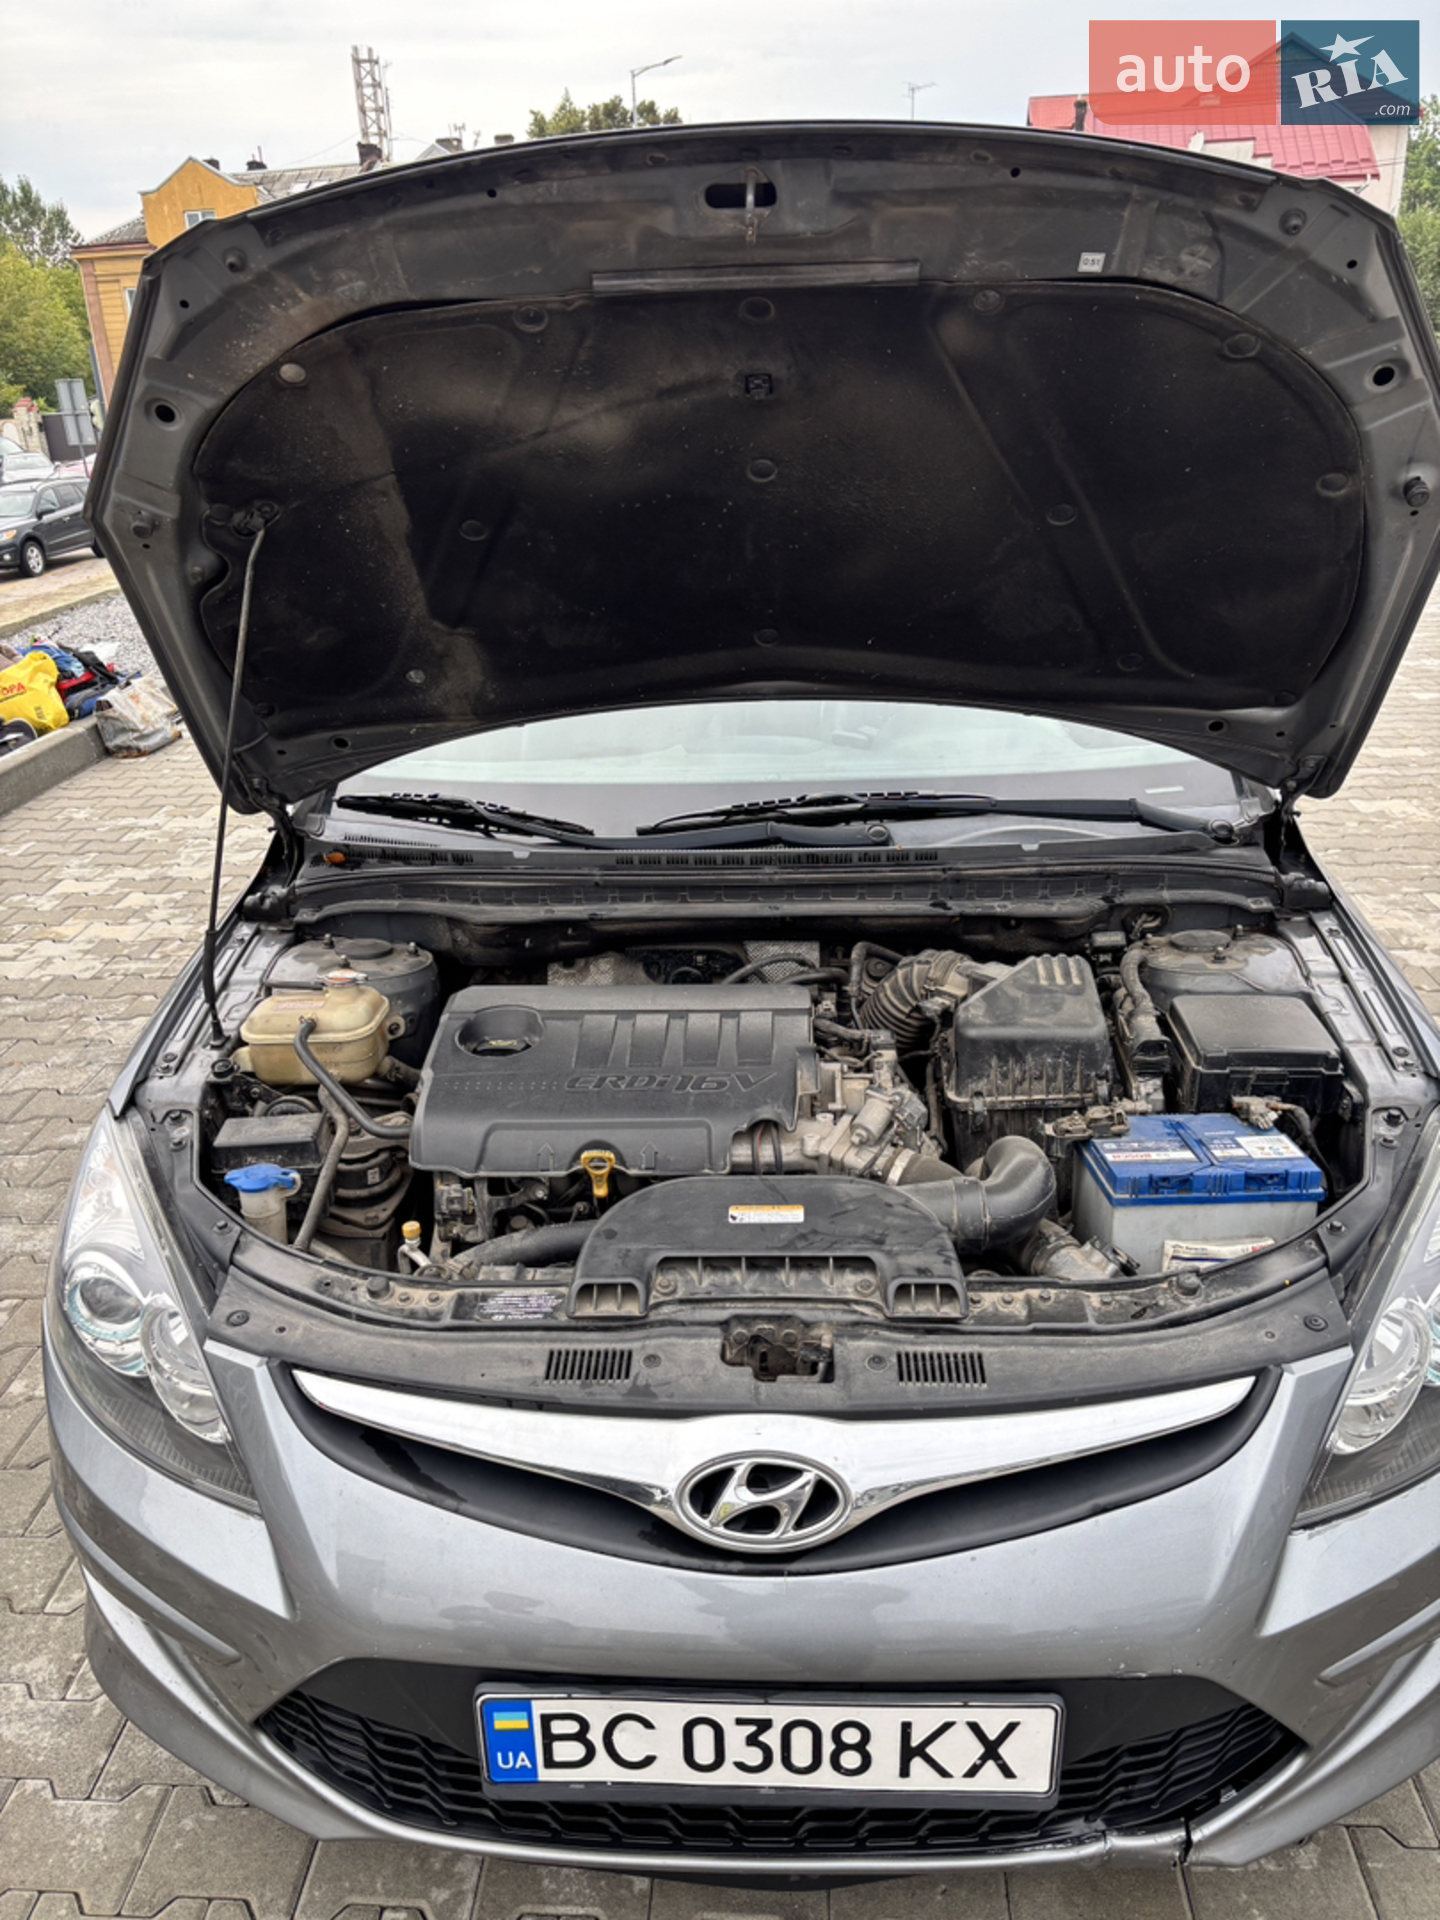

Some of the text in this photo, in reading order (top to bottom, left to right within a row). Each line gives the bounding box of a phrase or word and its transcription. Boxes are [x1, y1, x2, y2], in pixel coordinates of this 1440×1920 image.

[497, 1751, 533, 1770] UA
[539, 1712, 1022, 1779] BC 0308 KX
